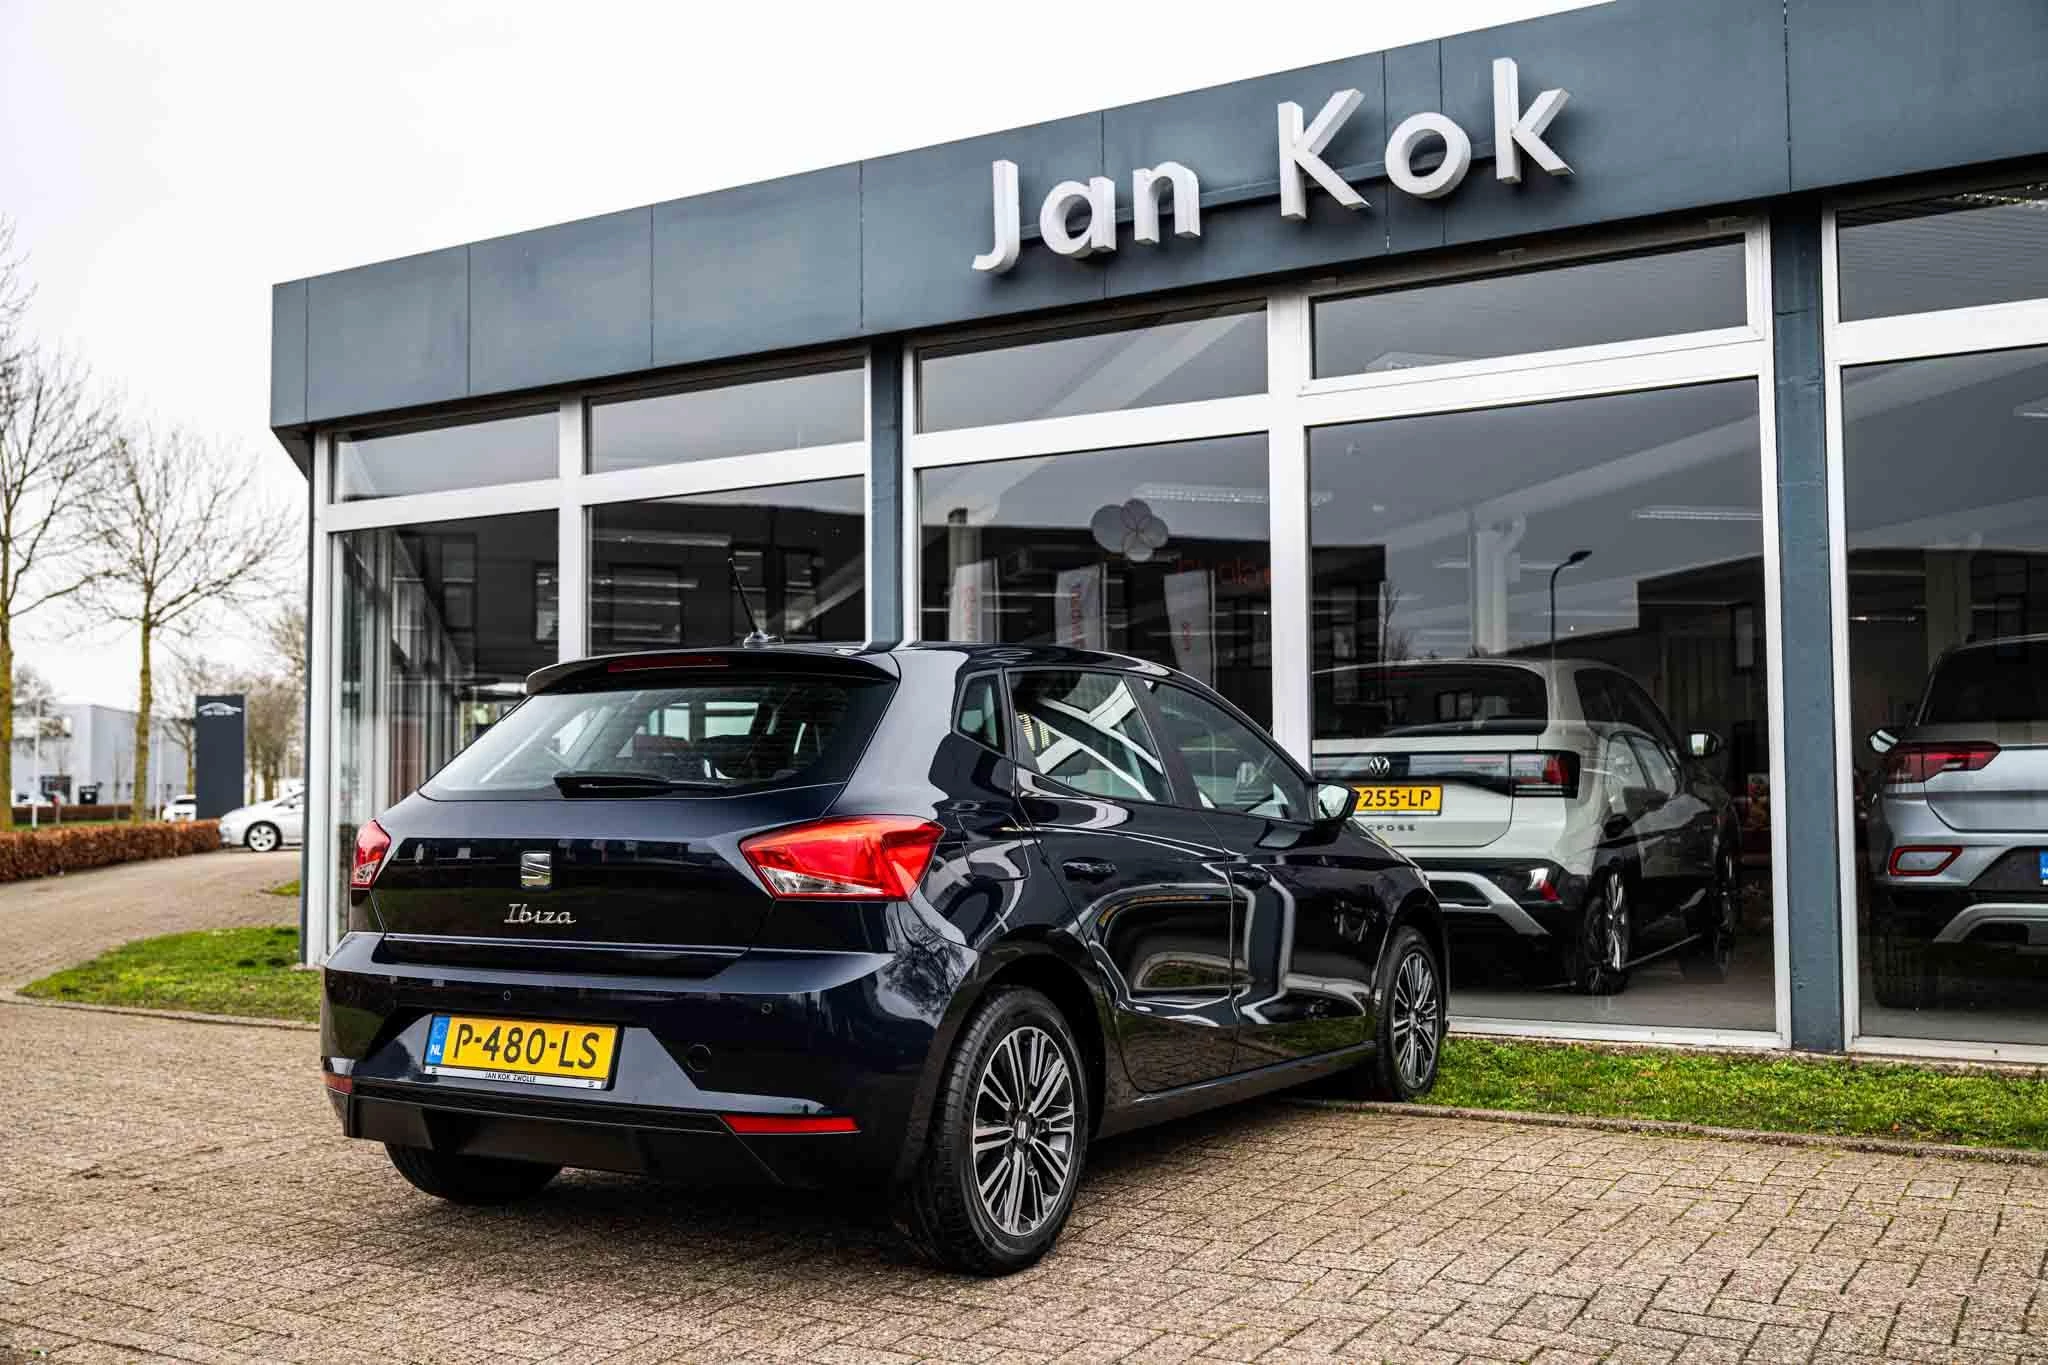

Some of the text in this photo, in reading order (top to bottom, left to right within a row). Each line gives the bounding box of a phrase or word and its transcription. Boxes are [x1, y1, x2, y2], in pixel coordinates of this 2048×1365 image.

[972, 57, 1575, 273] Jan Kok
[1360, 789, 1432, 807] 255-LP
[503, 903, 577, 924] Ibiza
[430, 1044, 442, 1056] NL
[453, 1023, 600, 1069] P-480-LS
